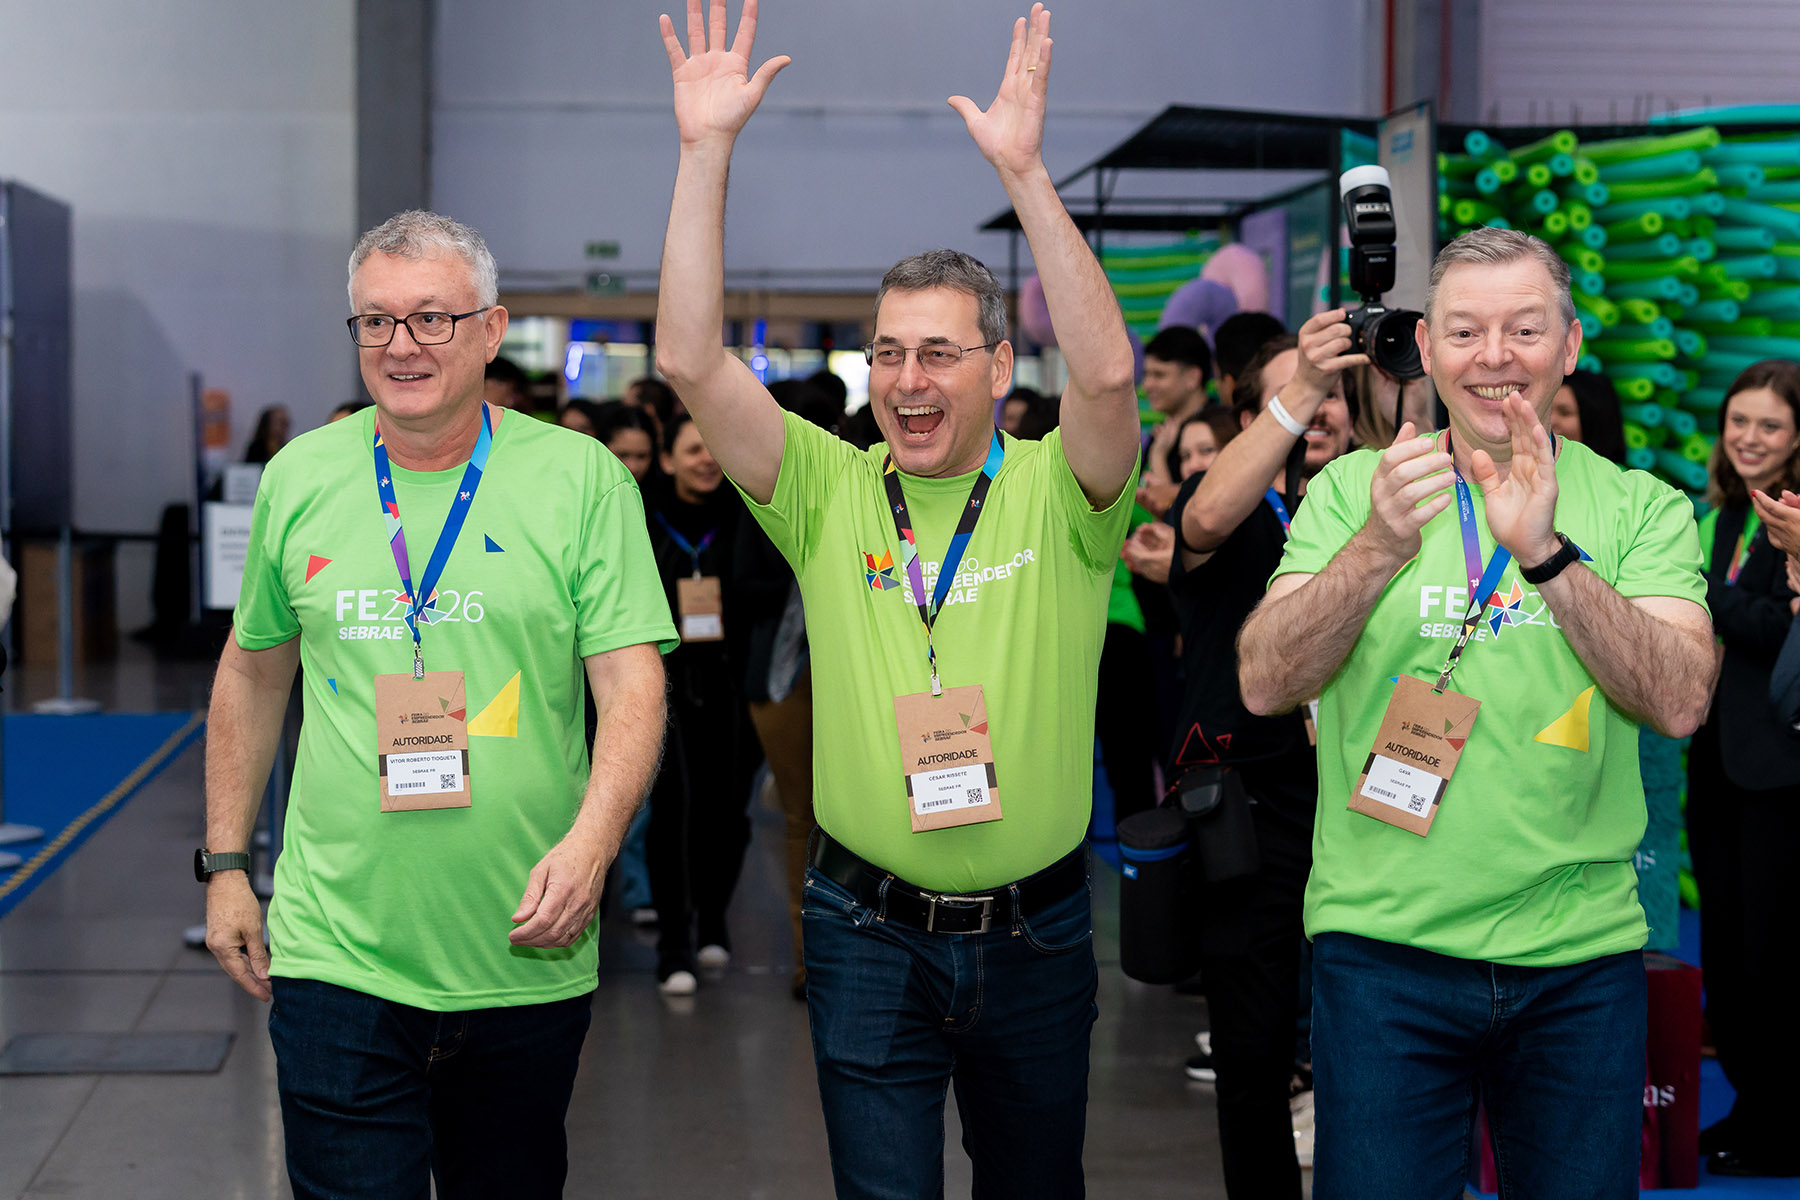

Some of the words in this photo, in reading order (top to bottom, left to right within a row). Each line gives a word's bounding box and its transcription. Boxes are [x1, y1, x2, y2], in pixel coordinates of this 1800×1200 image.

[338, 626, 404, 640] SEBRAE
[1419, 623, 1489, 642] SEBRE
[392, 735, 453, 747] AUTORIDADE
[917, 749, 978, 766] AUTORIDADE
[1385, 741, 1441, 768] AUTORIDADE
